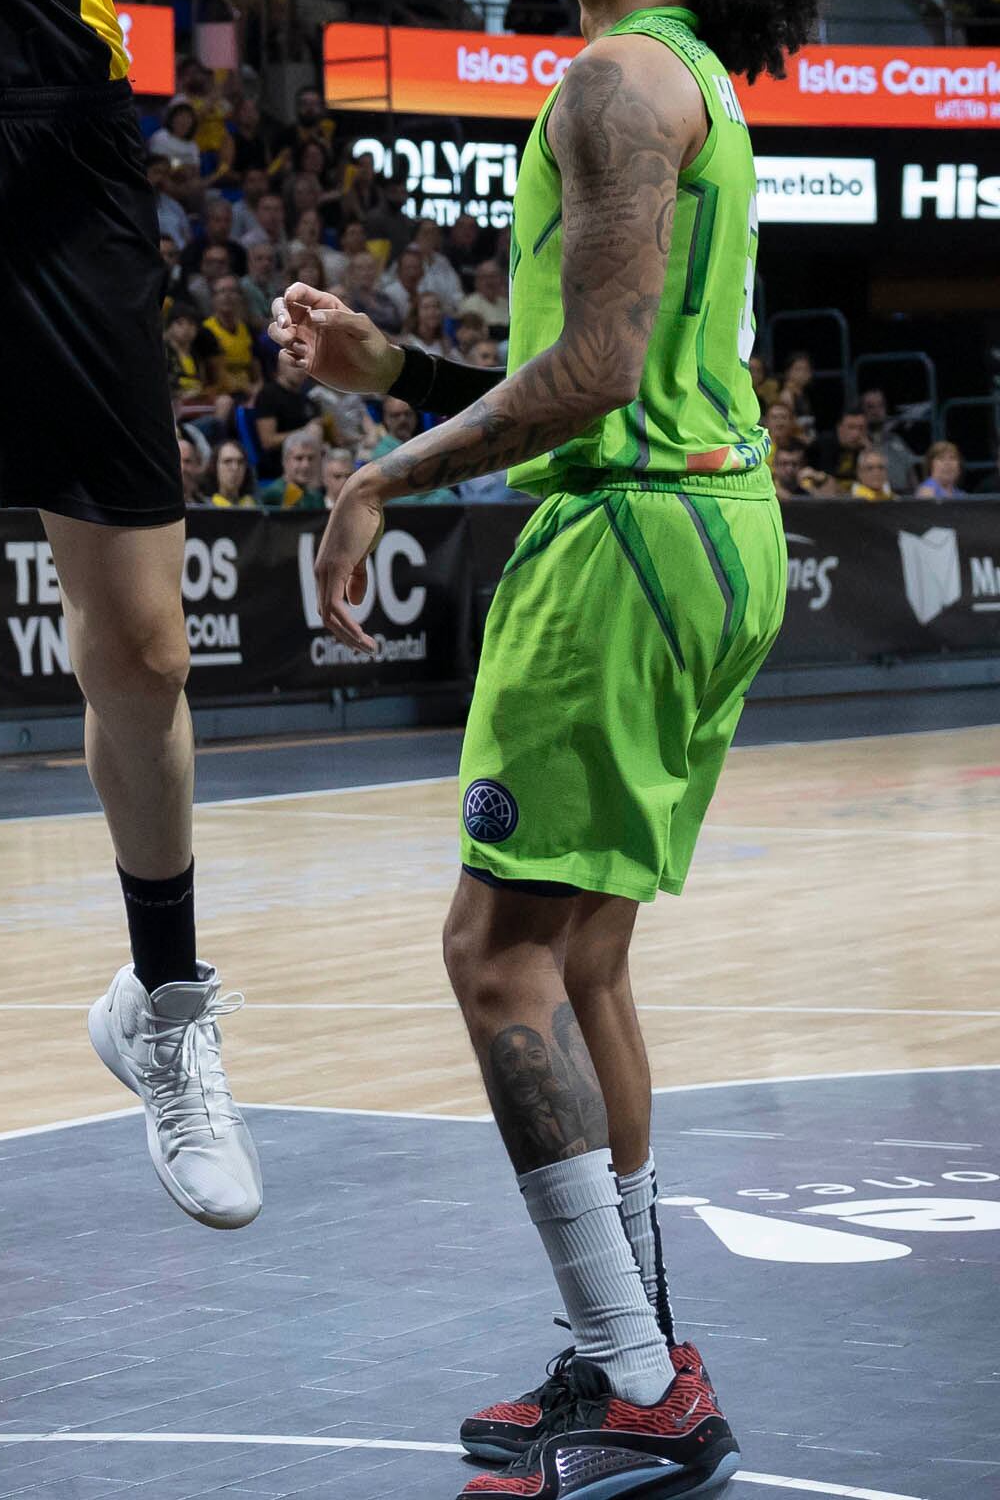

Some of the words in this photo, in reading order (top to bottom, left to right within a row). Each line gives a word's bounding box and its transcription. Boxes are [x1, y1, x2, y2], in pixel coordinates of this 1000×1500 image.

[457, 46, 529, 85] Islas
[799, 59, 878, 95] Islas
[756, 173, 864, 197] metabo
